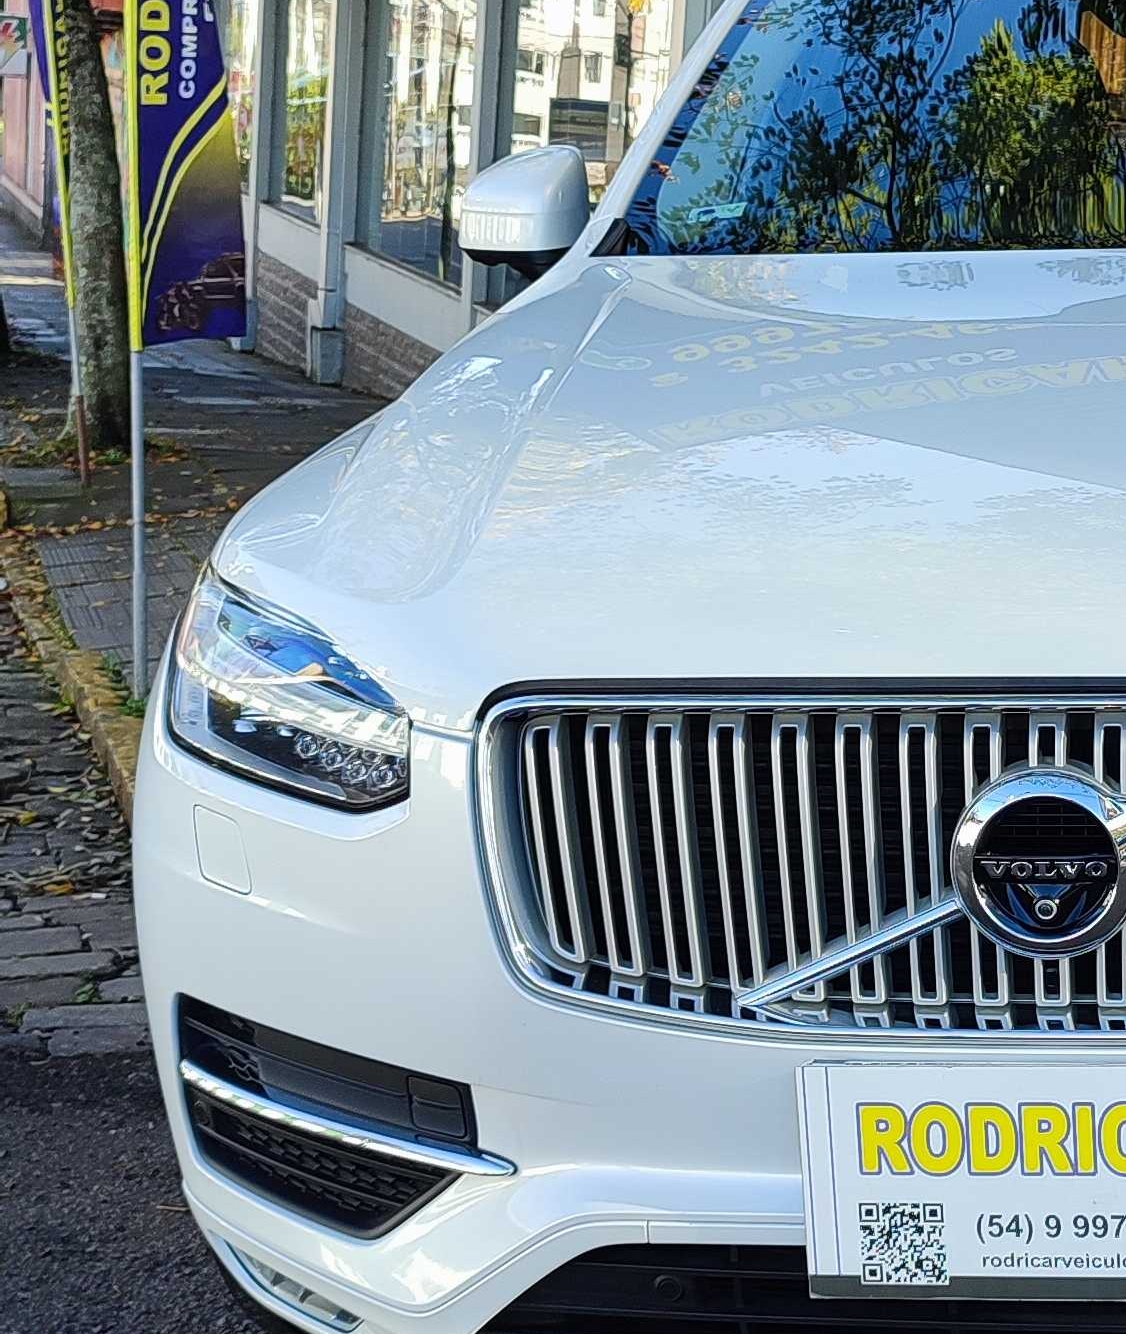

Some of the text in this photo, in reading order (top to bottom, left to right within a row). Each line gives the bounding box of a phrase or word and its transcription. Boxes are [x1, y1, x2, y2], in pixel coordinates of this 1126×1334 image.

[980, 860, 1108, 879] VOLVO
[975, 1213, 1034, 1245] (54)
[1044, 1214, 1062, 1240] 9
